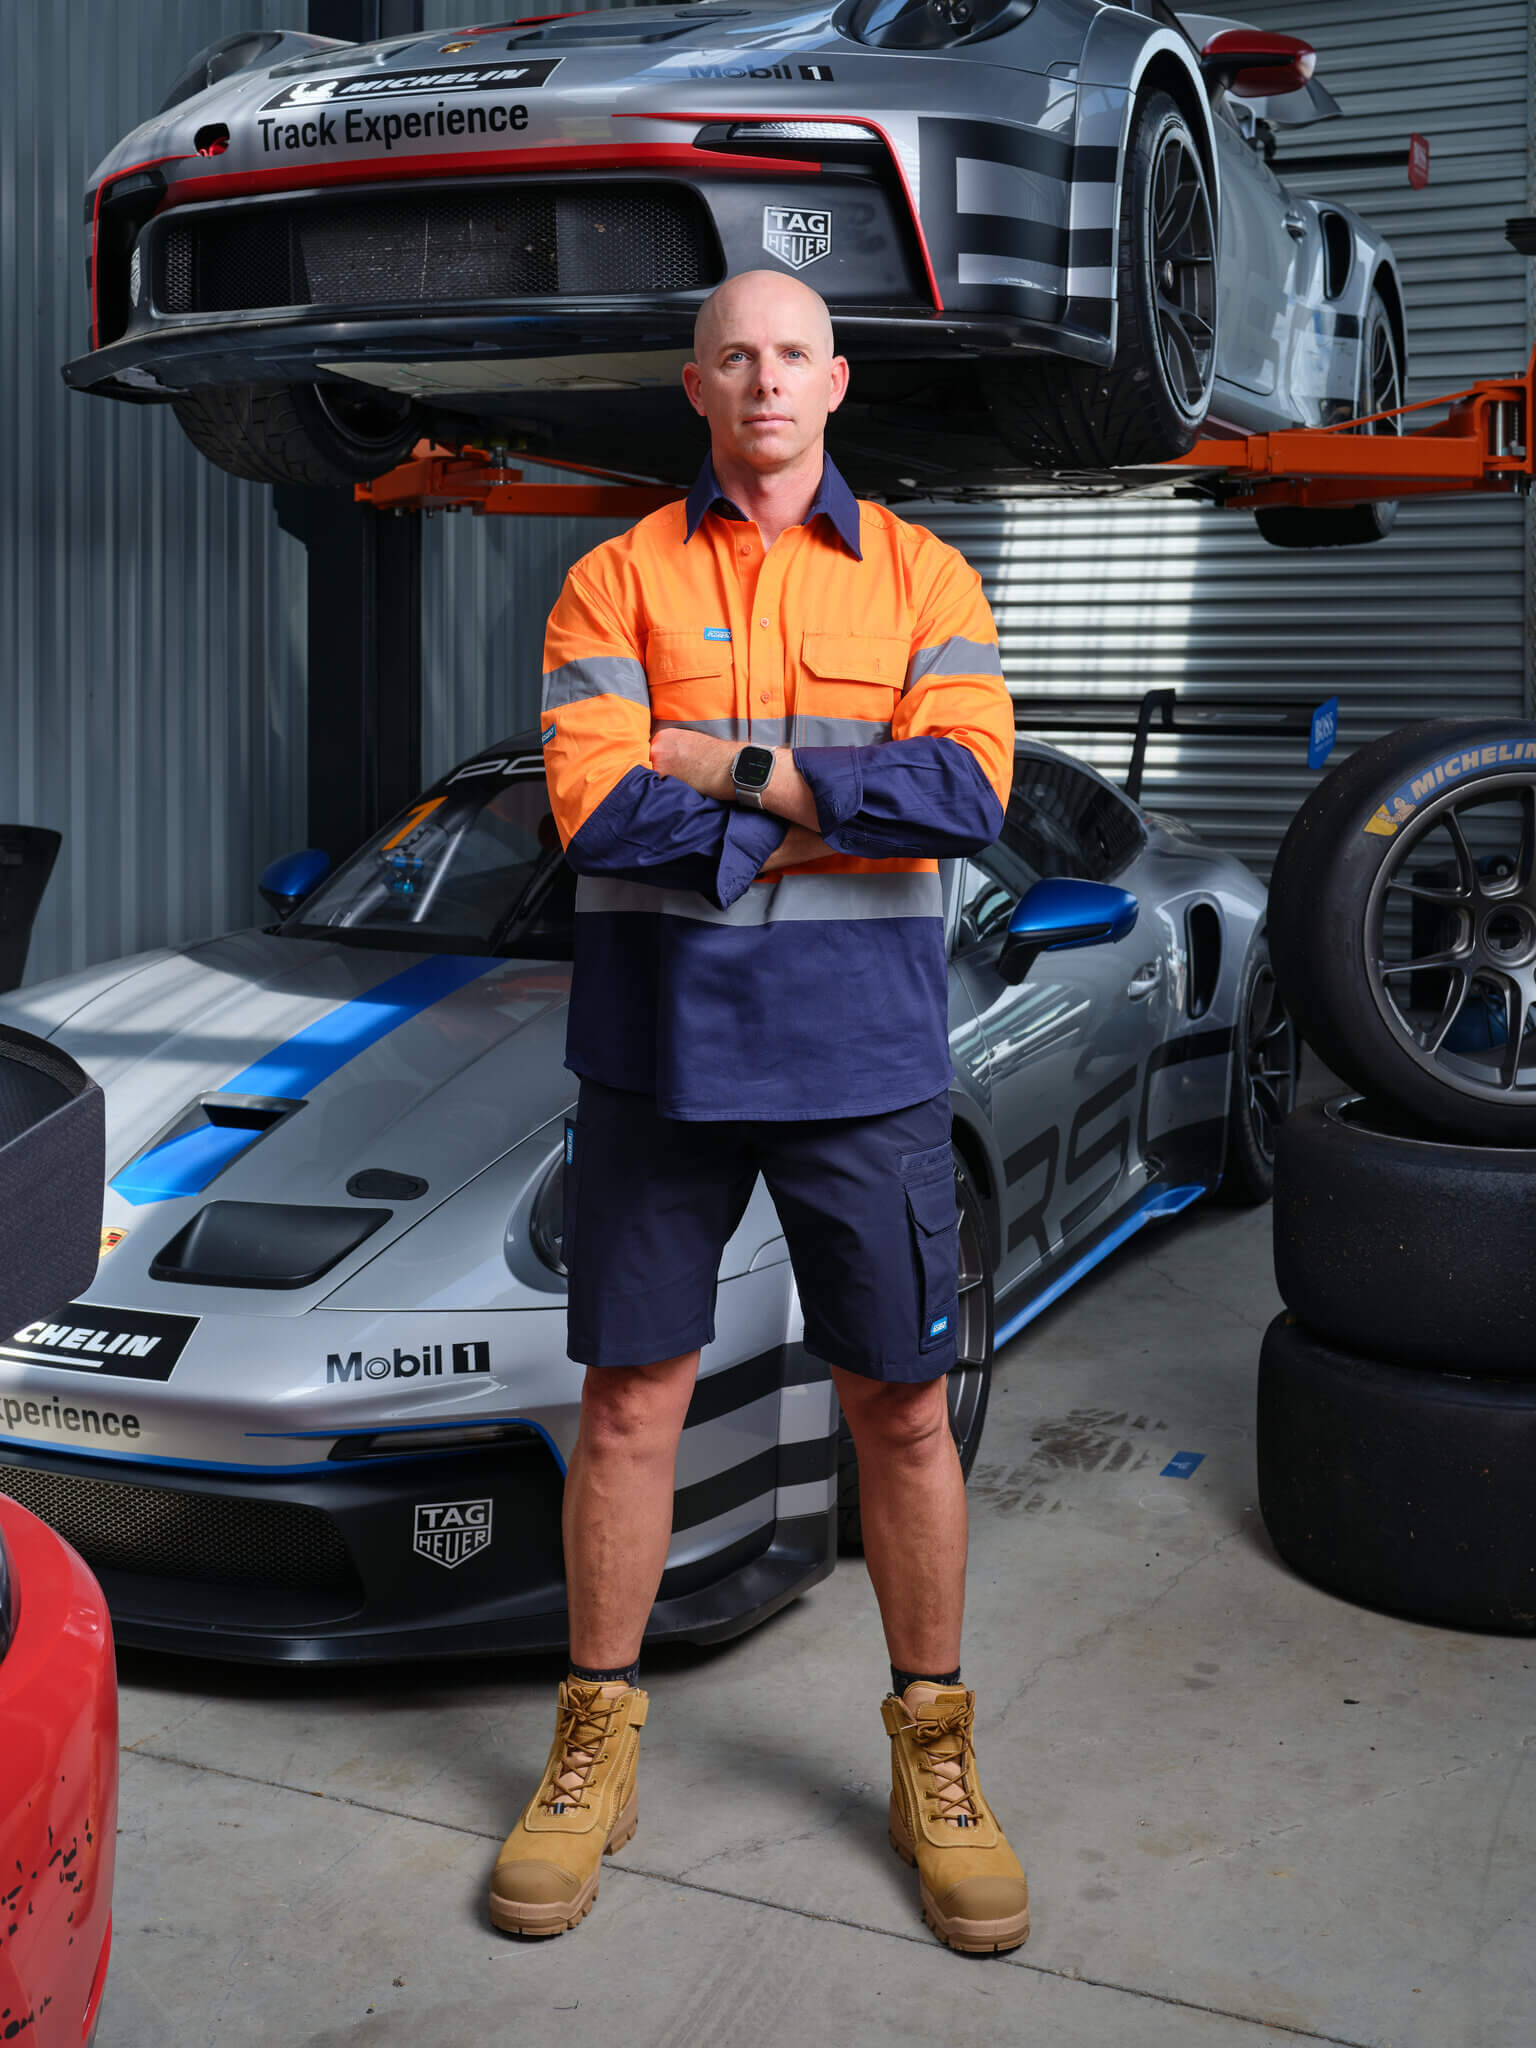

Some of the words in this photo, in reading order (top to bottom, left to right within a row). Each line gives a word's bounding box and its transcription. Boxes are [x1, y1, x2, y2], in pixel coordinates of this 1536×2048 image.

[339, 68, 530, 94] MICHELIN
[688, 64, 792, 80] Mobil
[257, 111, 337, 152] Track
[345, 101, 529, 150] Experience
[770, 210, 826, 233] TAG
[768, 234, 827, 265] HEUER
[1410, 742, 1536, 801] MICHELIN
[326, 1344, 443, 1384] Mobil
[422, 1504, 485, 1529] TAG
[418, 1530, 486, 1564] HEUER
